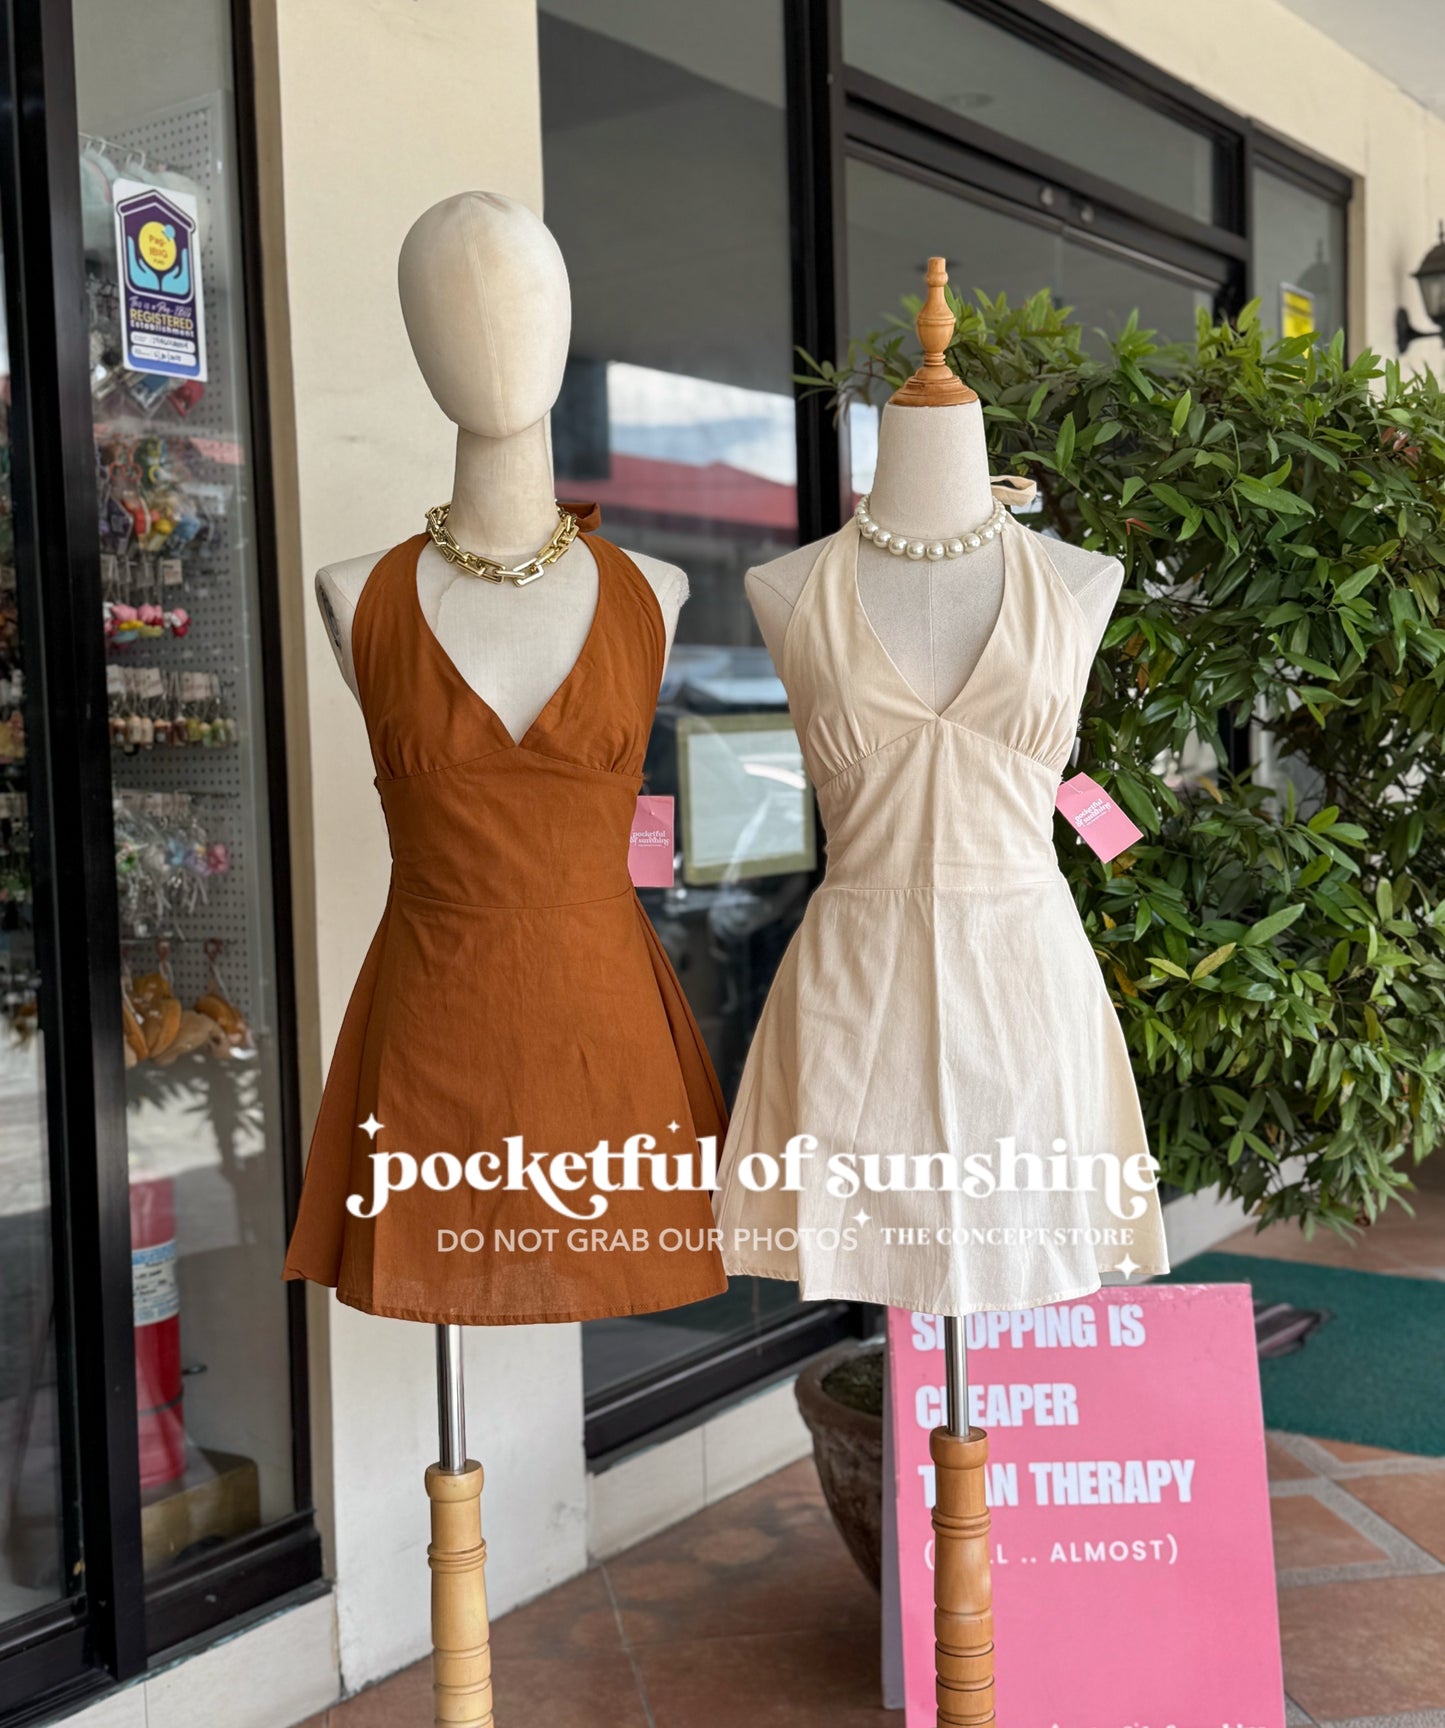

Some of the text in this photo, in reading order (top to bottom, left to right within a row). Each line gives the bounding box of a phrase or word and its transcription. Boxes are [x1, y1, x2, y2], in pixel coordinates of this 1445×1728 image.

[129, 308, 194, 330] REGISTERED
[130, 320, 194, 338] Establishment
[1108, 1304, 1146, 1347] IS
[917, 1459, 1196, 1508] TN THERAPY
[1050, 1533, 1178, 1565] ALMOST)
